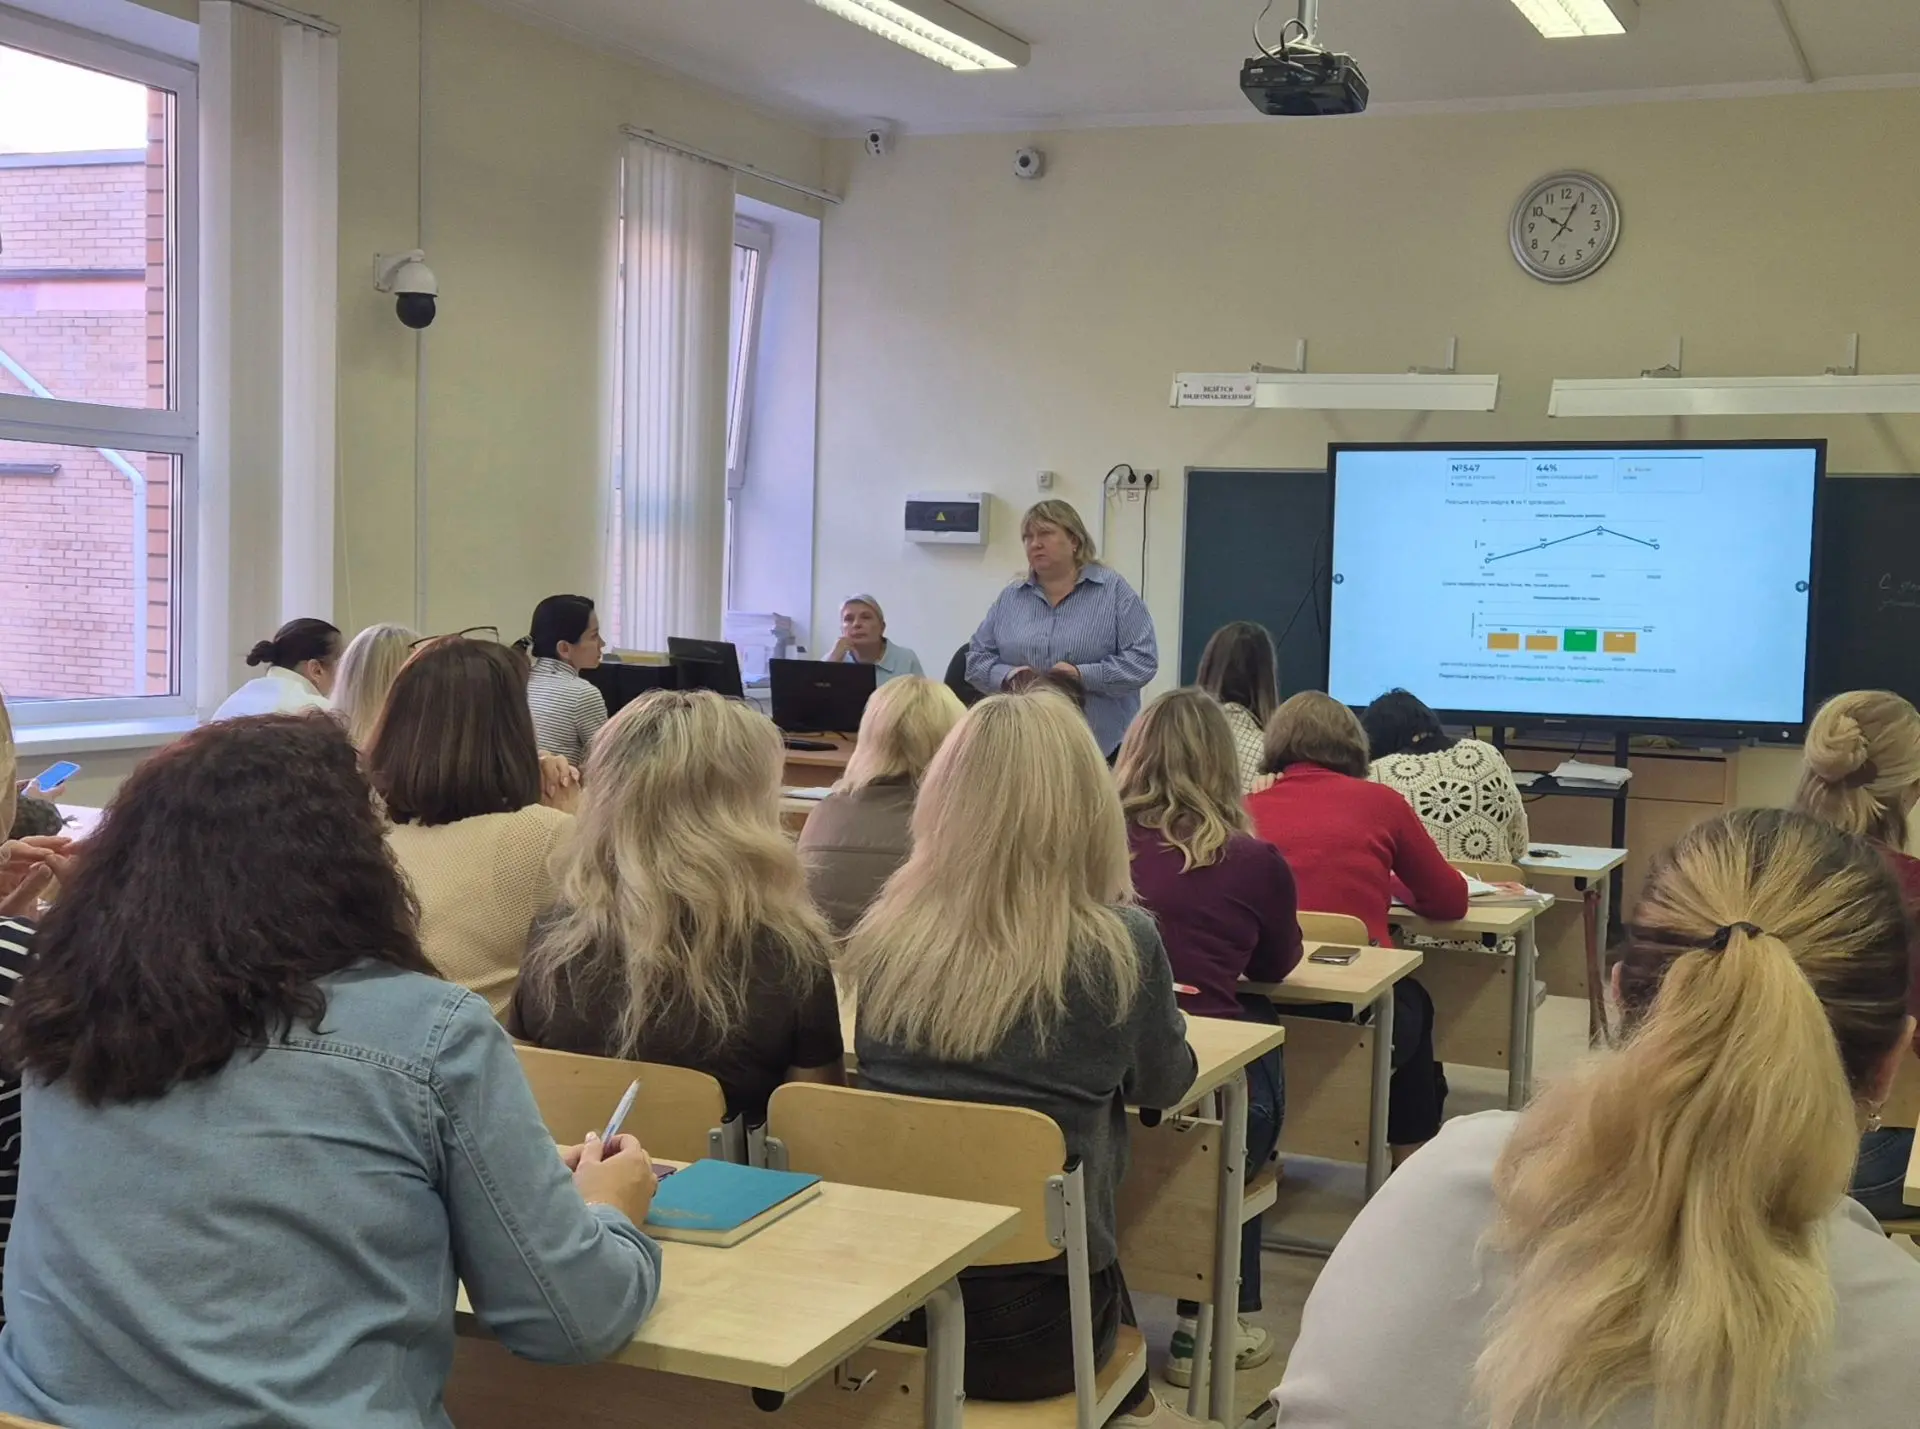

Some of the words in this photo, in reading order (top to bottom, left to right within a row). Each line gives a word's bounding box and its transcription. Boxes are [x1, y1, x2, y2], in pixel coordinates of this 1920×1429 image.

[1546, 193, 1554, 205] 11
[1561, 188, 1572, 200] 12
[1580, 192, 1585, 203] 1
[1533, 206, 1543, 217] 10
[1590, 204, 1598, 215] 2
[1528, 222, 1535, 233] 9
[1593, 220, 1601, 232] 3
[1531, 239, 1538, 250] 8
[1587, 237, 1596, 248] 4
[1542, 250, 1550, 261] 7
[1558, 254, 1566, 265] 6
[1575, 249, 1582, 261] 5
[1536, 463, 1558, 472] 44%
